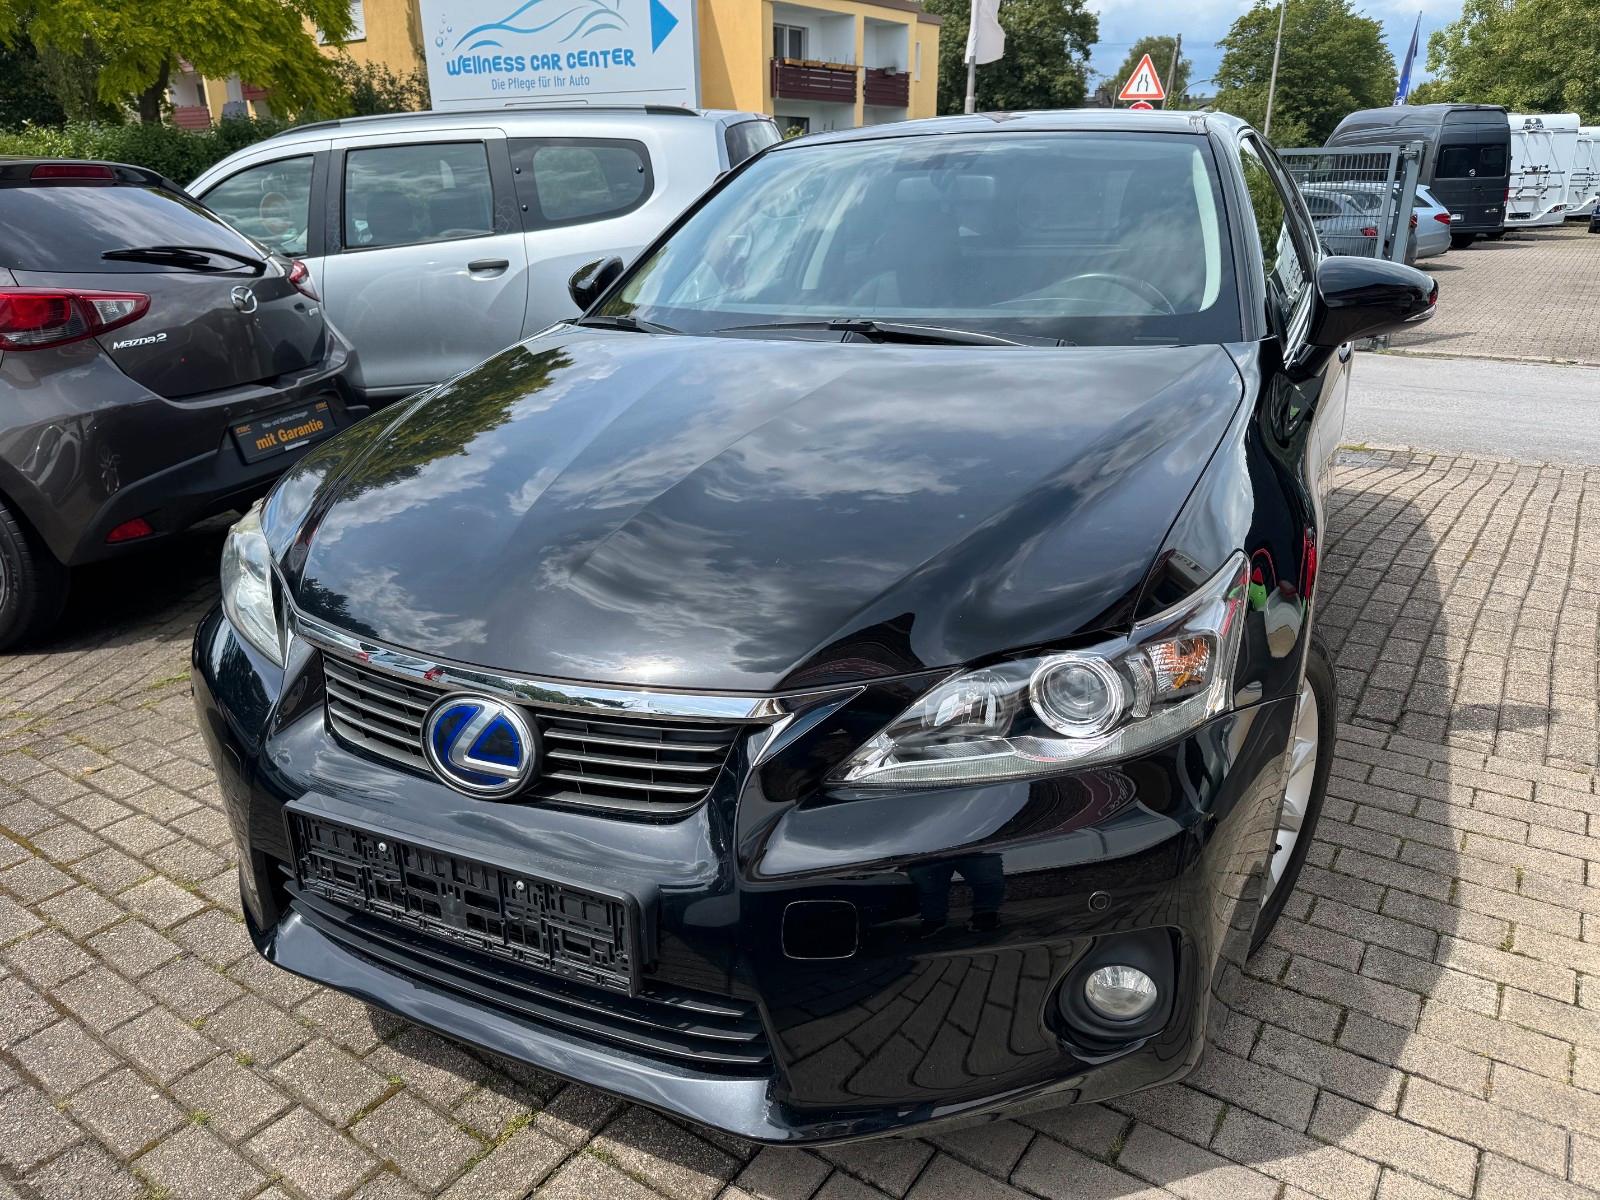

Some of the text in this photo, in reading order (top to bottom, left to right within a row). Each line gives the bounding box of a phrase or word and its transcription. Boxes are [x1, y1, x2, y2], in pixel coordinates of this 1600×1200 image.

[530, 53, 563, 71] CAR
[491, 74, 590, 91] Die Pflege für Ihr Auto
[255, 433, 277, 450] mit
[277, 418, 324, 442] Garantie
